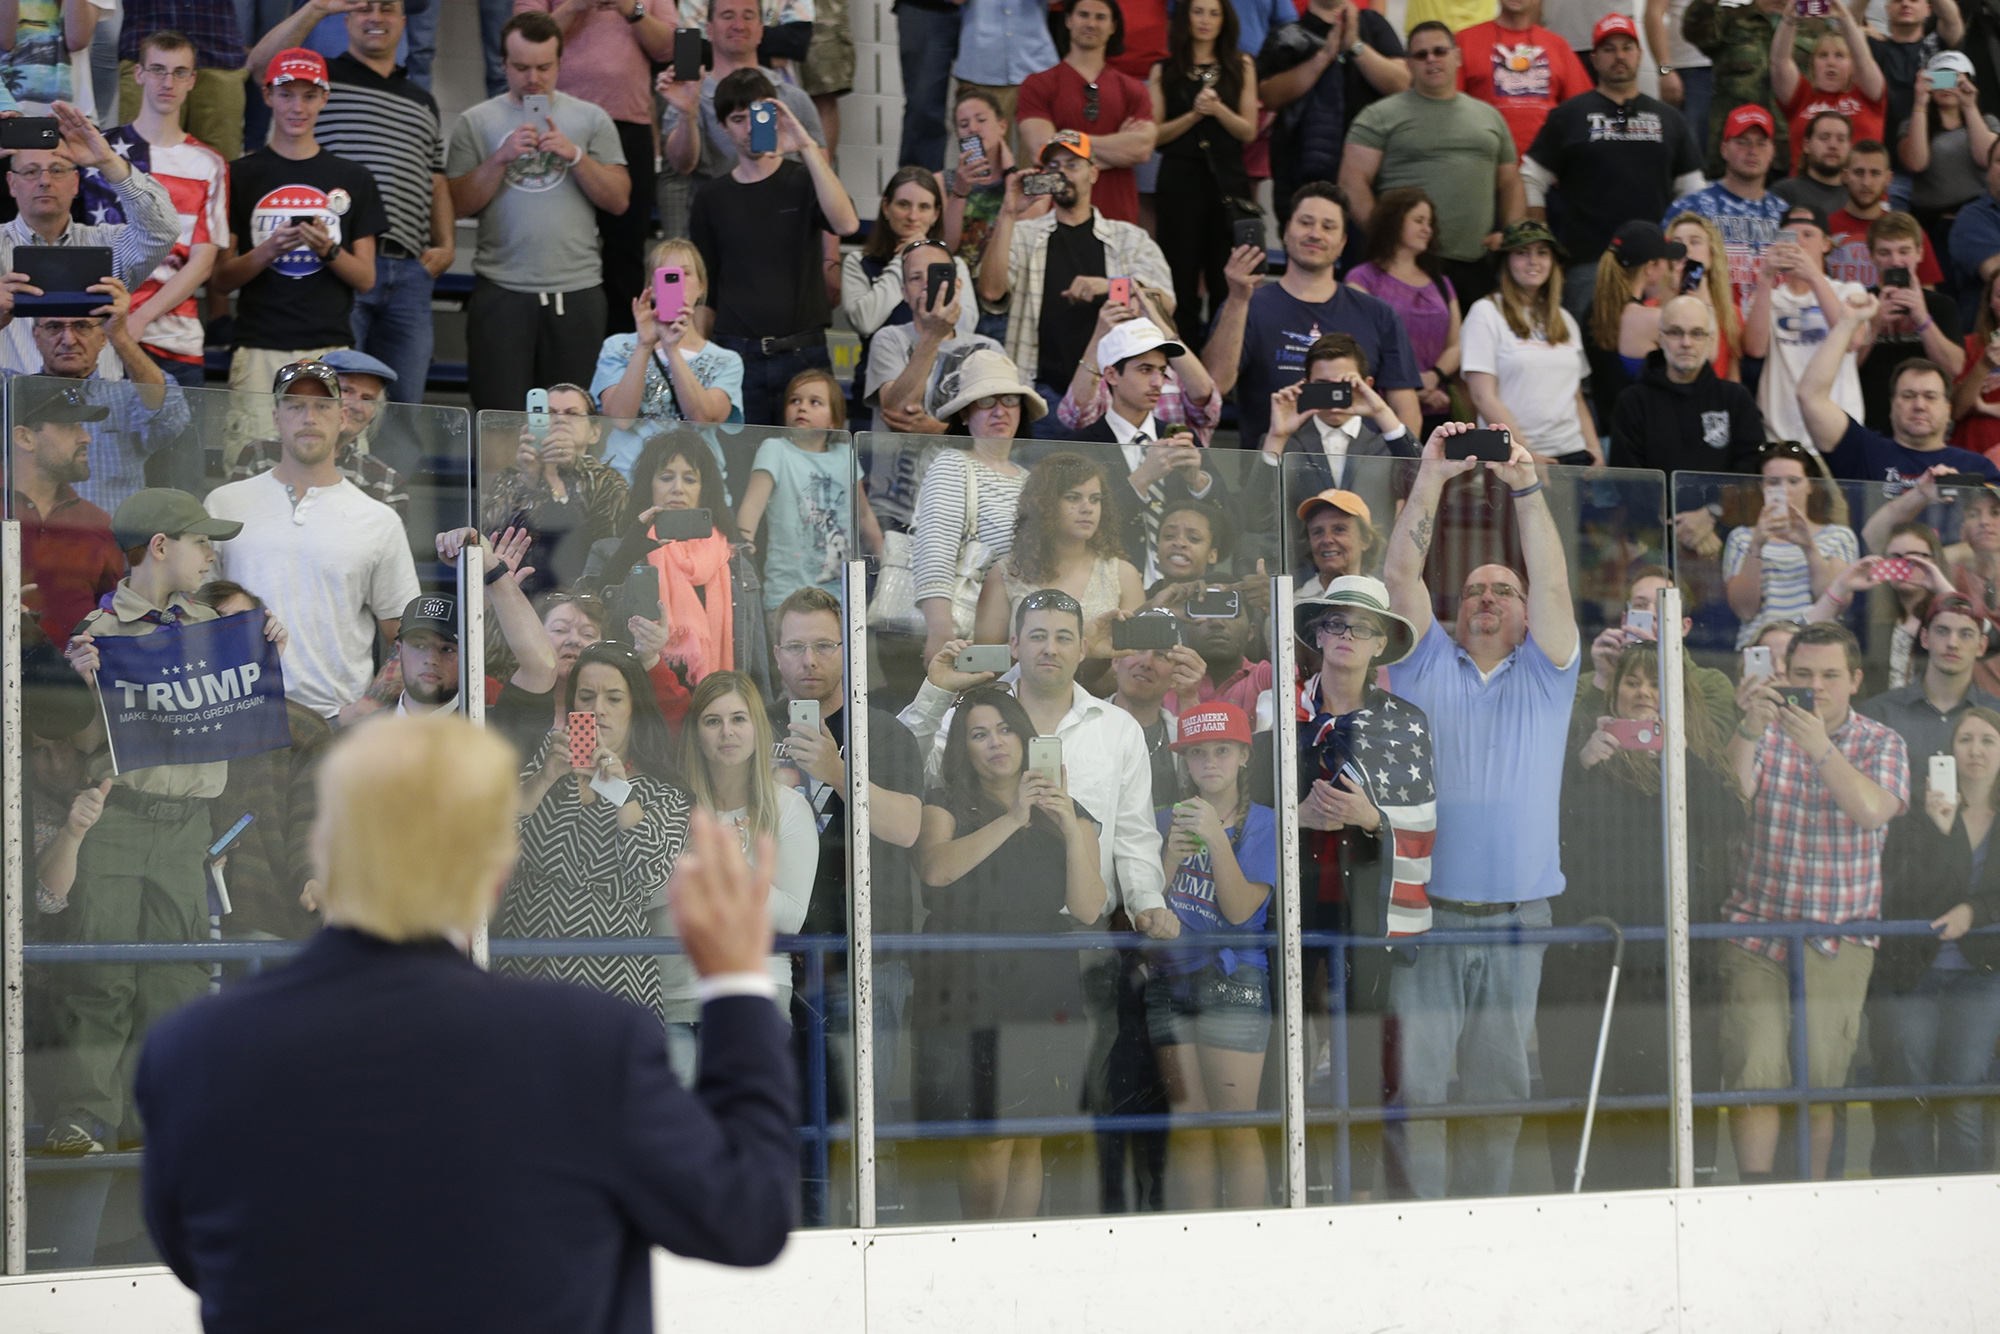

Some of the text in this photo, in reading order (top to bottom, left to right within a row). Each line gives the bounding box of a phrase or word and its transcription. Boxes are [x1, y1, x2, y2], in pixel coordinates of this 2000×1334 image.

[1587, 112, 1662, 134] Trmp
[115, 662, 261, 712] TRUMP
[119, 694, 265, 723] MAKE AMERICA GREAT AGAIN!
[1196, 712, 1229, 723] AMERICA
[1201, 722, 1226, 732] AGAIN
